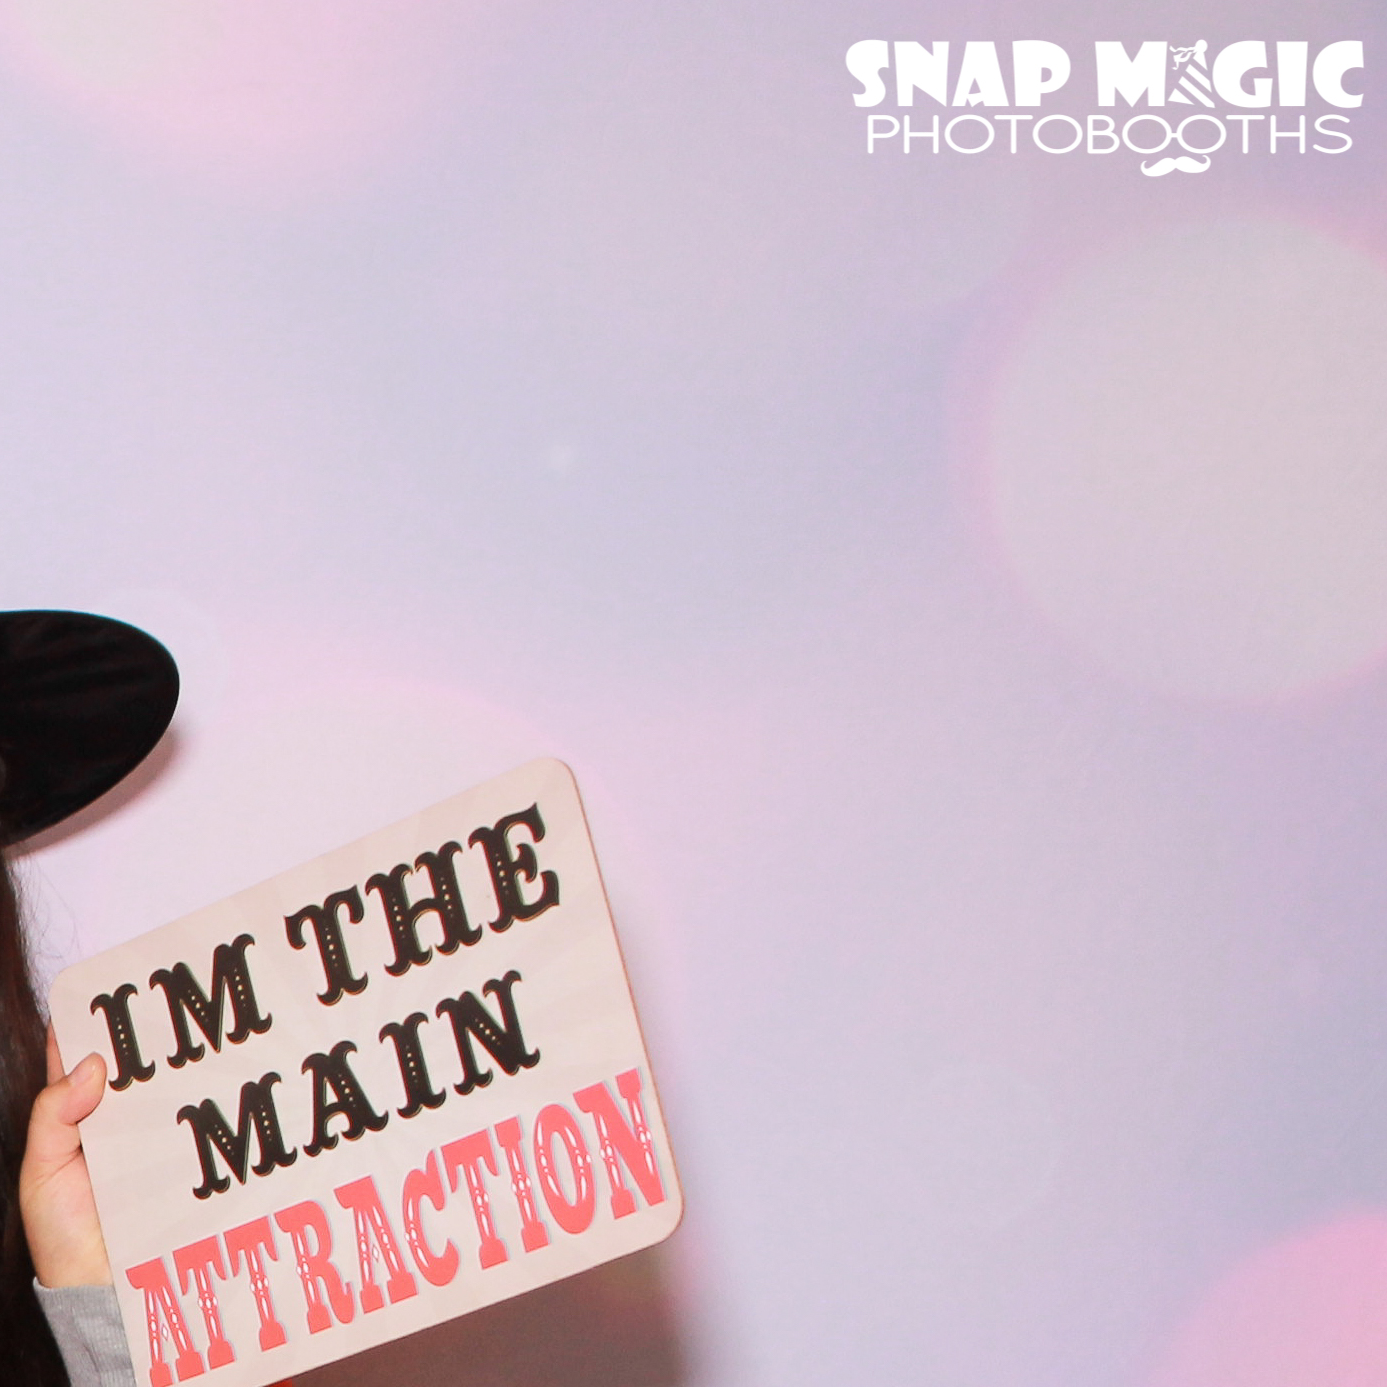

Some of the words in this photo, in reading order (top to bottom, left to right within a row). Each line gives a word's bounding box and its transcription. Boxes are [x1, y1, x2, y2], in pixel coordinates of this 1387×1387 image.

[90, 932, 272, 1092] IM
[283, 802, 560, 1007] THE
[176, 969, 541, 1200] MAIN
